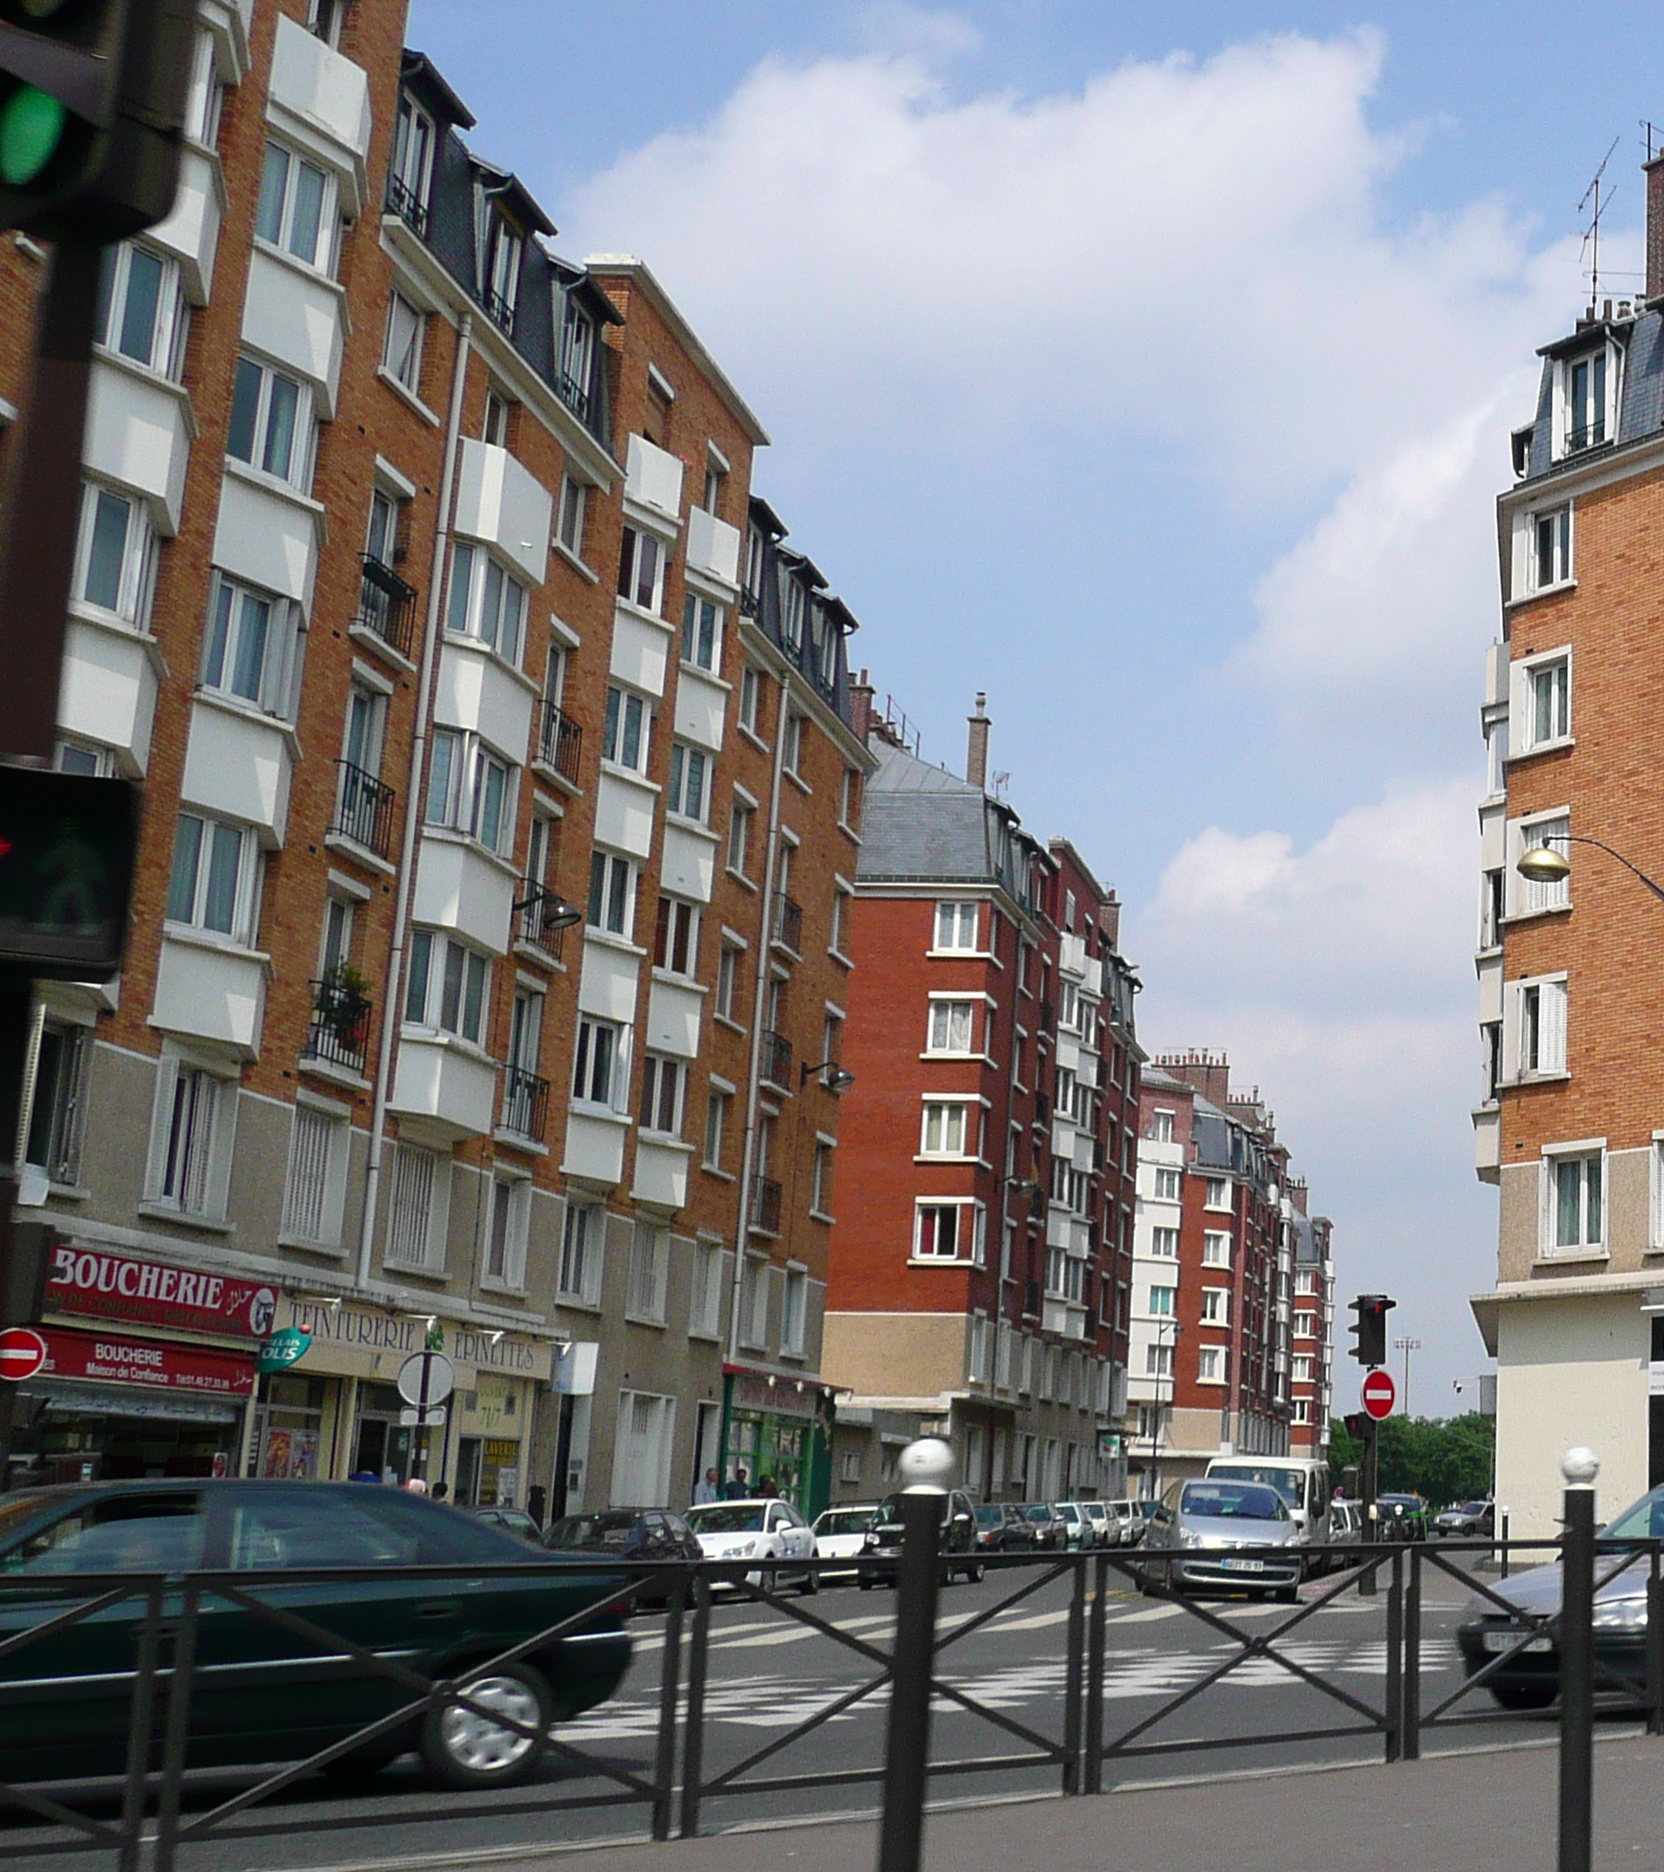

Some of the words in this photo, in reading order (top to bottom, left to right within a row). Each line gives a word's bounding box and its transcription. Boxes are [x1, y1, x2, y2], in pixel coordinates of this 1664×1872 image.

[51, 1249, 224, 1309] BOUCHERIE
[290, 1302, 415, 1351] TEINTURERIE
[95, 1343, 163, 1367] BOUCHERIE
[261, 1347, 298, 1360] OLIS
[454, 1331, 534, 1370] EPINETTES
[86, 1361, 116, 1378] Maison
[117, 1365, 130, 1379] de
[130, 1368, 169, 1384] Confiance
